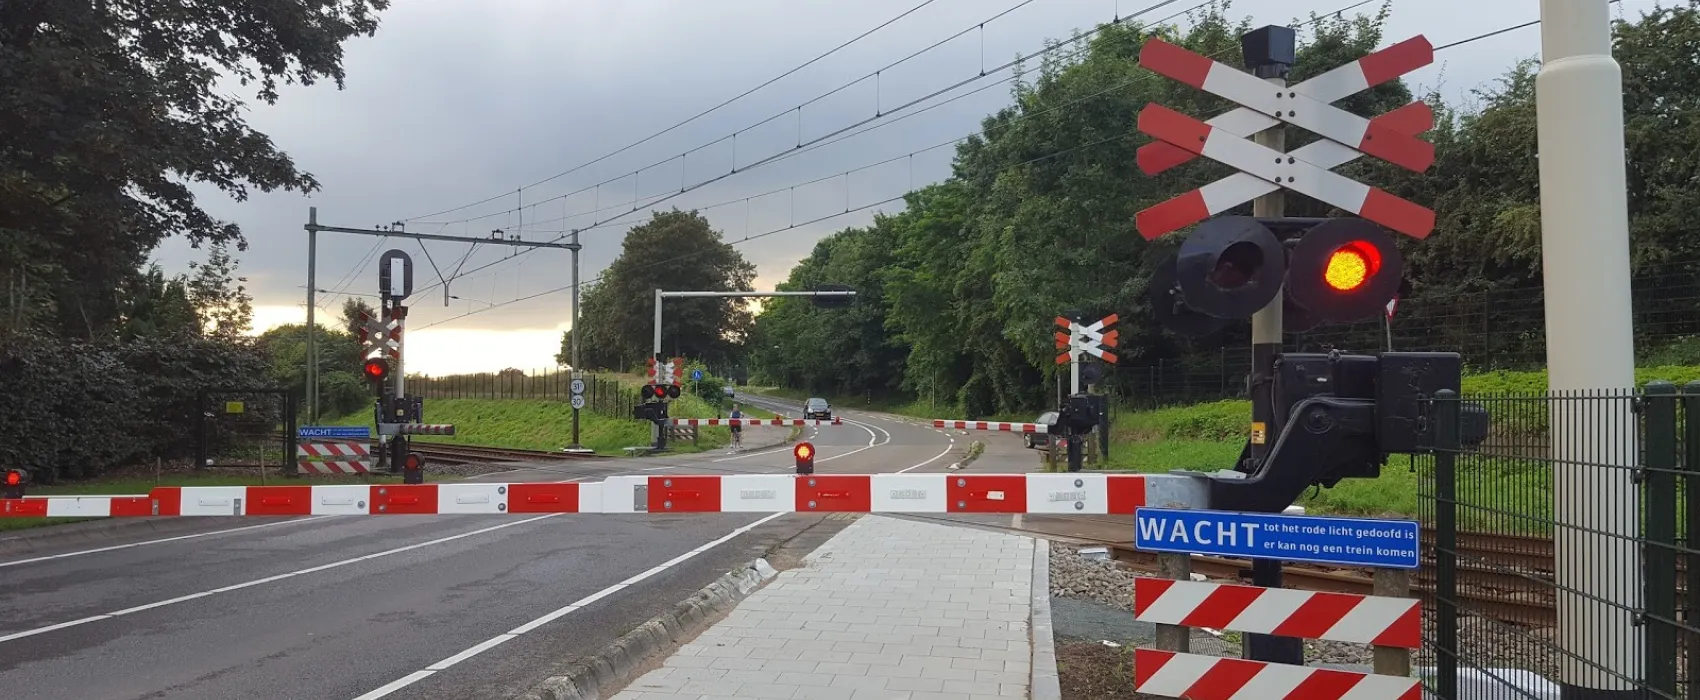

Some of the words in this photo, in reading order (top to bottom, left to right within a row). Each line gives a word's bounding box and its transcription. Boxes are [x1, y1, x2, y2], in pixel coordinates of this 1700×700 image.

[1138, 517, 1260, 548] WACHT
[1263, 523, 1280, 532] tot
[1282, 523, 1299, 533] het
[1302, 524, 1326, 535] rode
[1328, 525, 1353, 537] licht
[1356, 527, 1402, 539] gedoofd
[1404, 530, 1414, 540] is
[1263, 541, 1275, 549] er
[1277, 540, 1296, 550] kan
[1299, 543, 1320, 554] nog
[1323, 545, 1343, 554] een
[1346, 545, 1373, 555] trein
[1376, 546, 1415, 558] komen
